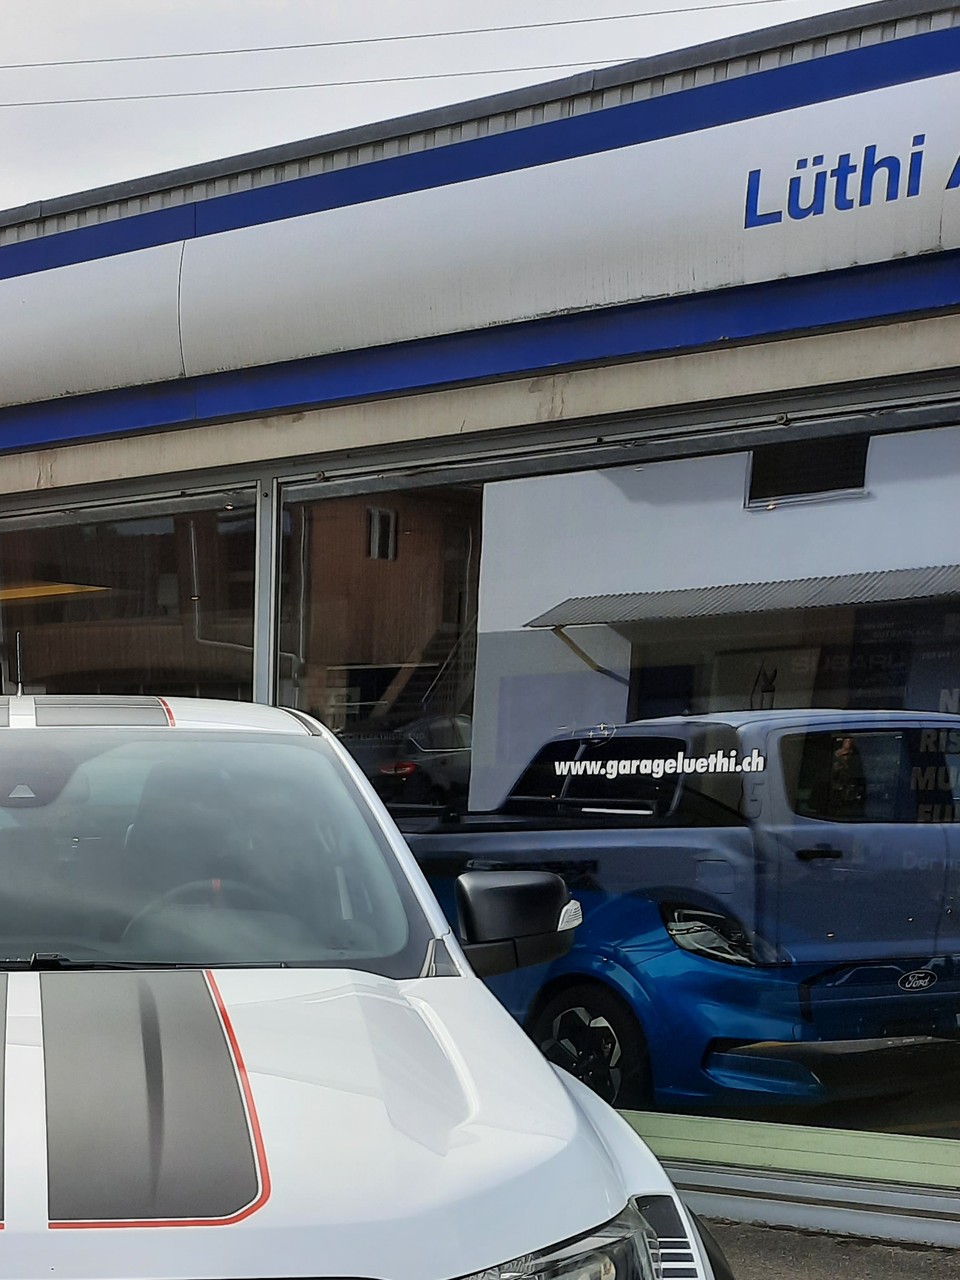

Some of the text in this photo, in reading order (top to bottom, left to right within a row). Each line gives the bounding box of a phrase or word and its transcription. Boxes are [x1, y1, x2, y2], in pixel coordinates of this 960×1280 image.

[743, 133, 926, 230] Lüthi
[554, 749, 765, 779] www.garageluethi.ch
[905, 973, 931, 988] Ford
